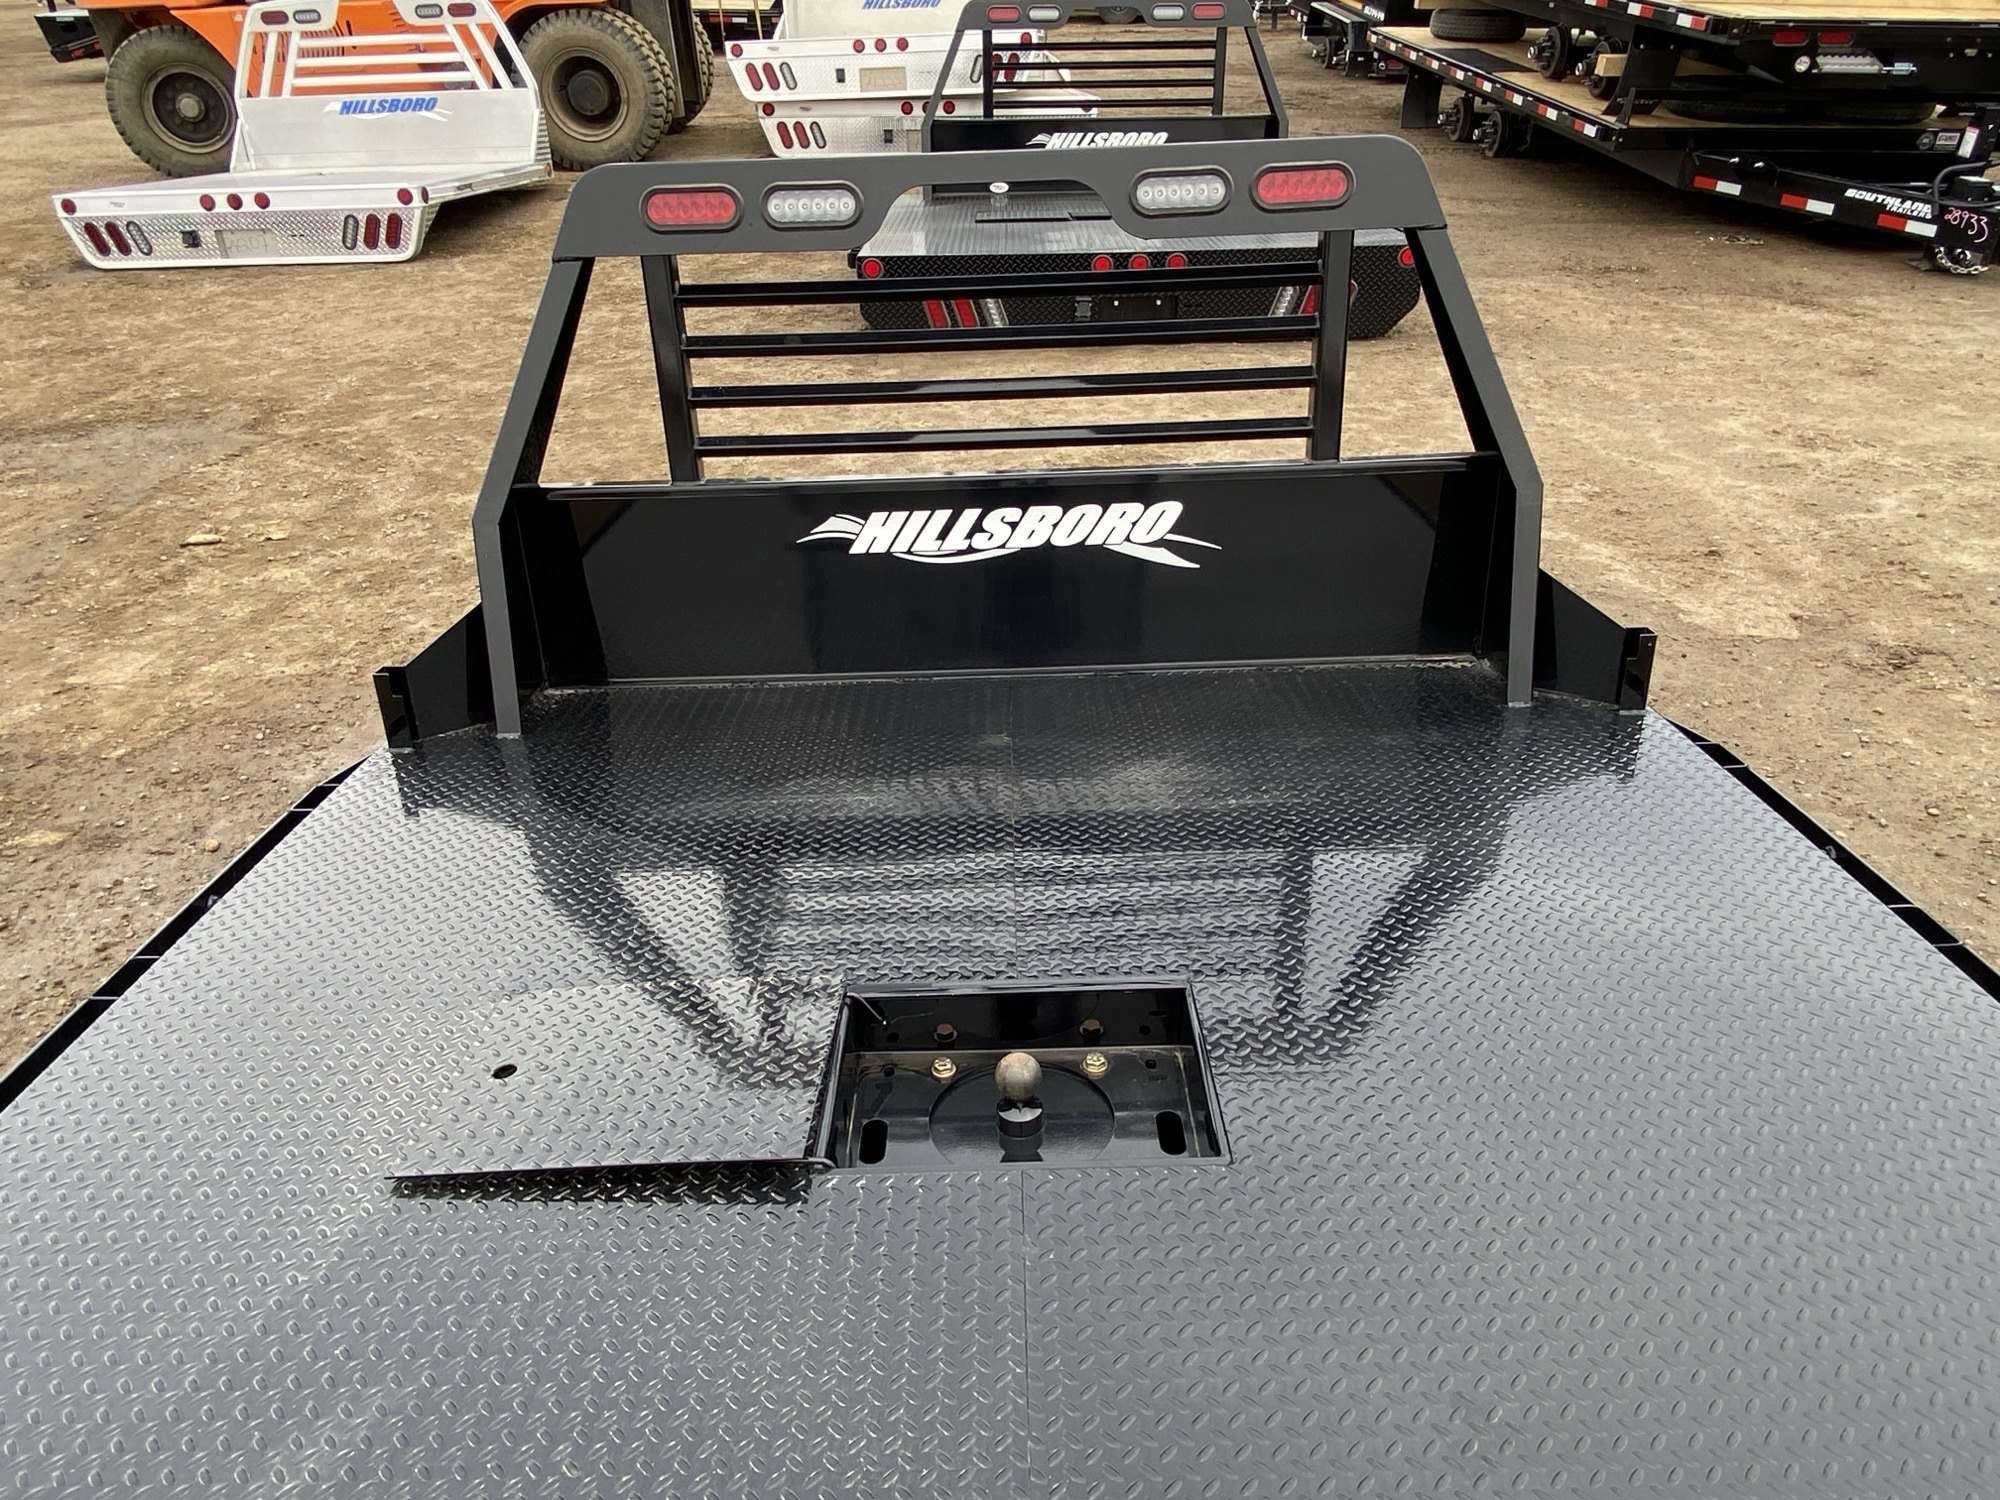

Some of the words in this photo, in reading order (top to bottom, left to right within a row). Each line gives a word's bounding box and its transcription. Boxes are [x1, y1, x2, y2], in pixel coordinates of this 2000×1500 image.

[339, 97, 438, 115] HILLSBORO
[1045, 131, 1169, 150] HILLSBORO
[1844, 188, 1932, 214] SOUTHLAND
[1886, 203, 1932, 219] TRAILERS
[1944, 207, 1989, 243] 28933
[849, 500, 1184, 555] HILLSBORO
